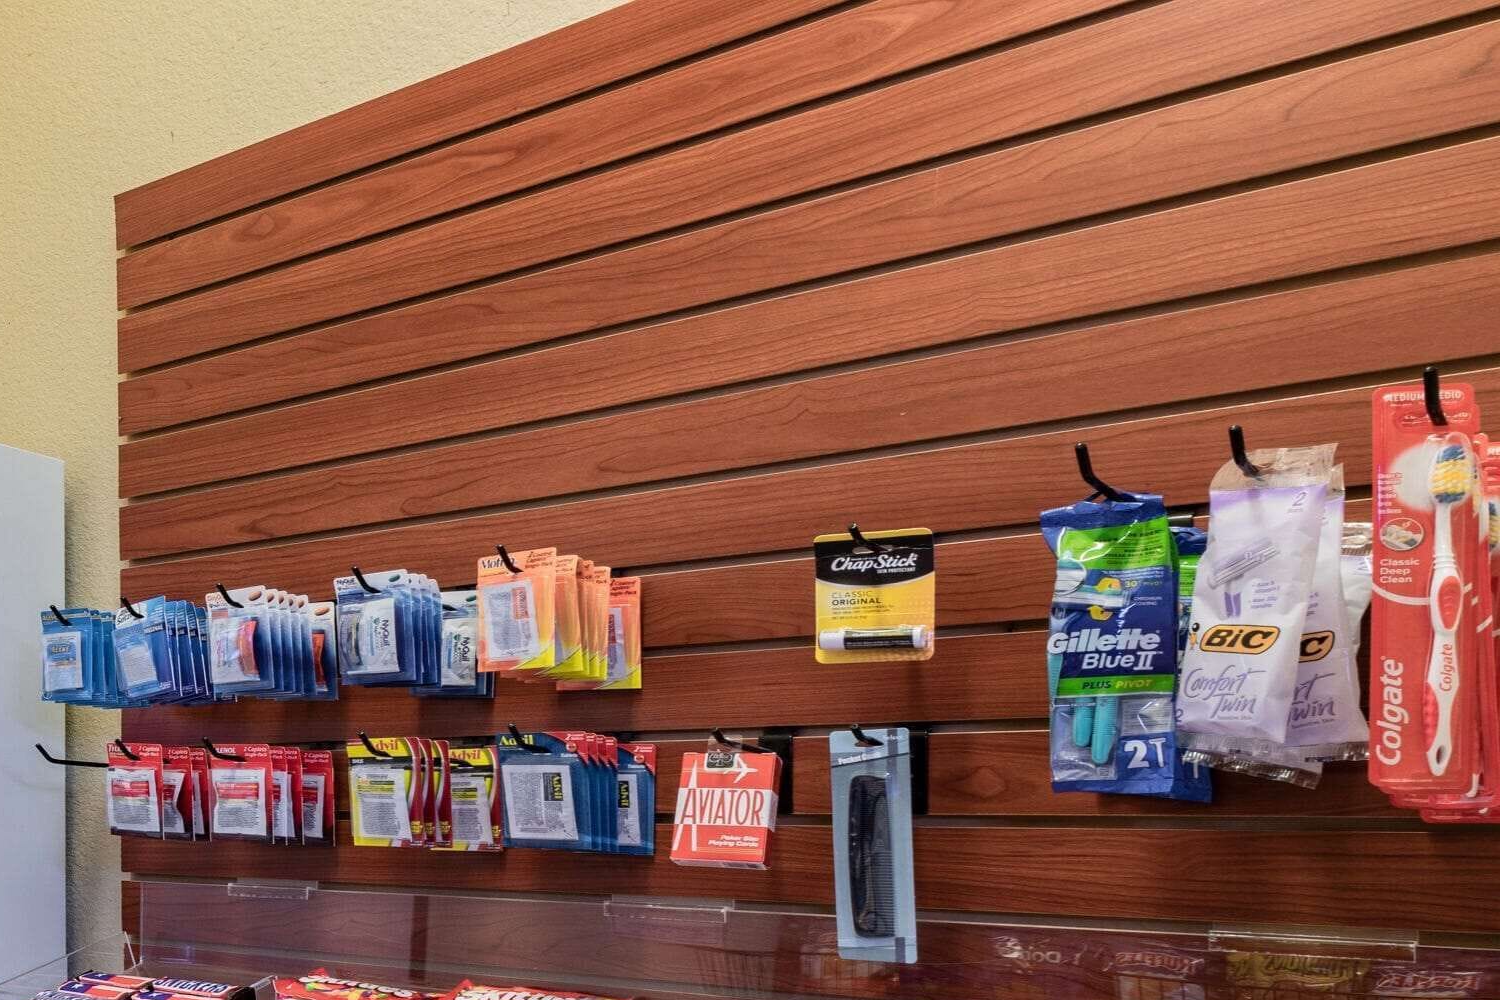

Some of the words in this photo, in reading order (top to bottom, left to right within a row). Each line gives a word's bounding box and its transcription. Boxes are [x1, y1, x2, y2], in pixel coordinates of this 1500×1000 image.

[1439, 390, 1462, 400] EDIO
[481, 556, 516, 570] Motn
[1379, 558, 1420, 566] Classic
[1379, 567, 1411, 575] Deep
[832, 591, 873, 599] CLASSIC
[832, 597, 882, 606] ORIGINAL
[381, 619, 391, 647] NyQuil
[1047, 628, 1161, 655] Gillette
[461, 636, 470, 662] NyQuil
[1082, 652, 1134, 670] Blue
[1439, 643, 1454, 693] Colgate
[1082, 680, 1111, 690] PLUS
[1115, 679, 1153, 689] PIVOT
[1184, 665, 1266, 700] Comfort
[1211, 694, 1257, 719] Twin
[1376, 658, 1404, 767] Colgate
[552, 774, 563, 800] Advil
[619, 783, 630, 808] Advil
